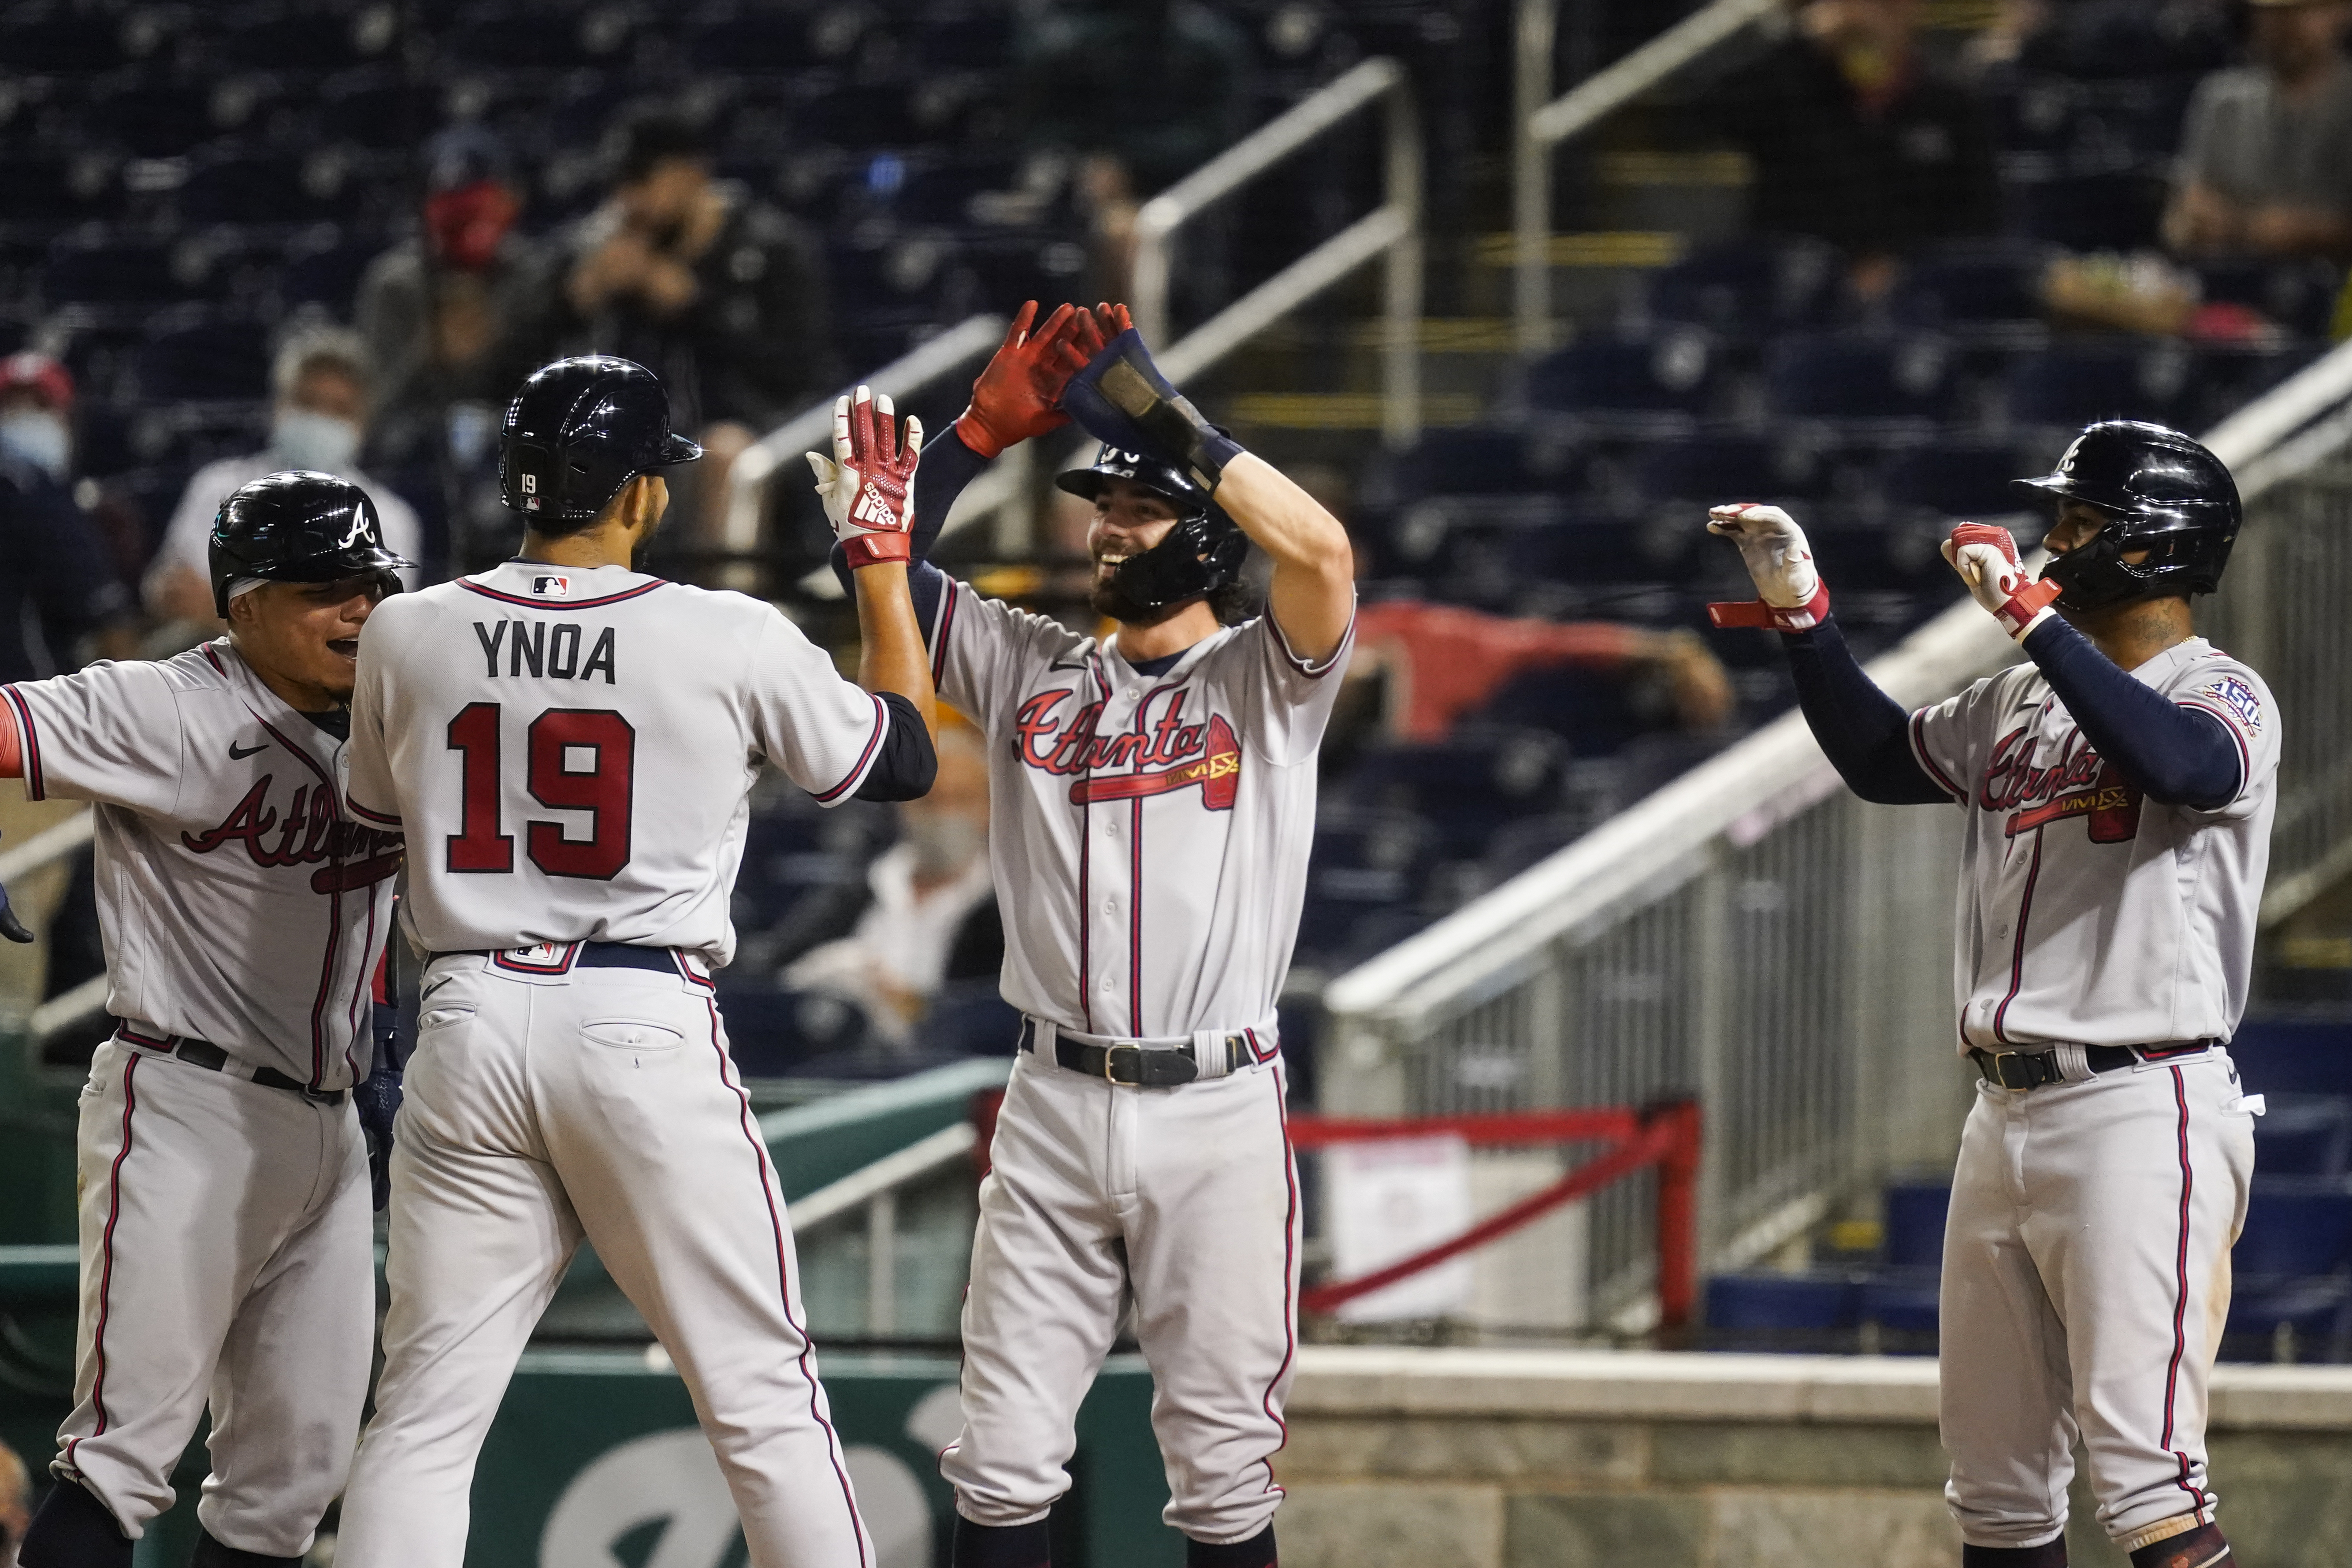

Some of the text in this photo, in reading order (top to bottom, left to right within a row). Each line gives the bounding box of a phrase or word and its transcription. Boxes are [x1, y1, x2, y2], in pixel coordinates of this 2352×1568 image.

[521, 473, 536, 494] 19
[864, 482, 897, 525] adidas
[338, 502, 375, 548] A
[473, 620, 616, 684] YNOA
[2215, 680, 2259, 724] 150
[2230, 679, 2258, 703] BRAVES
[1015, 688, 1205, 777] Atlanta
[446, 702, 635, 881] 19
